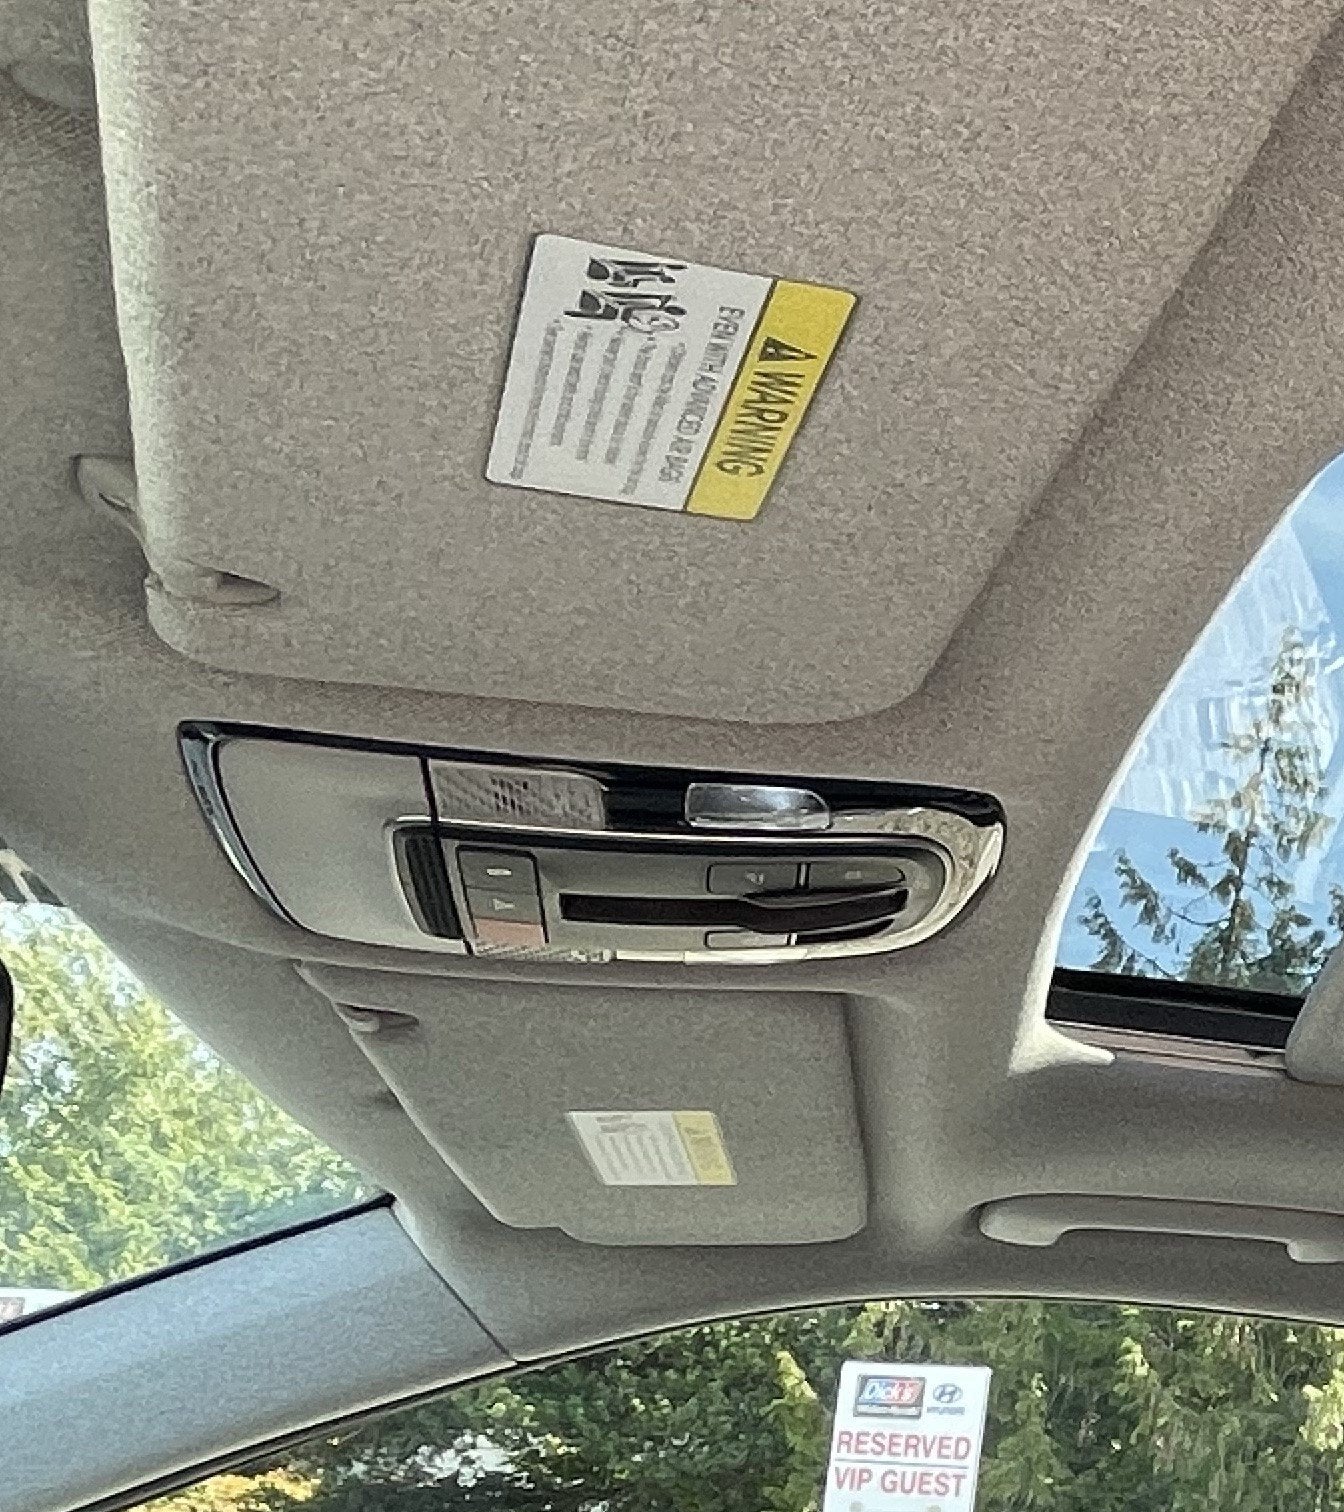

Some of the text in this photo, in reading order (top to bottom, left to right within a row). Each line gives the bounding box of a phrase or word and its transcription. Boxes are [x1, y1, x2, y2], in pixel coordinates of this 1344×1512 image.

[710, 306, 746, 341] EVEN
[715, 369, 806, 478] WARNING
[837, 1430, 972, 1460] RESERVED
[834, 1466, 967, 1498] VIP GUEST
